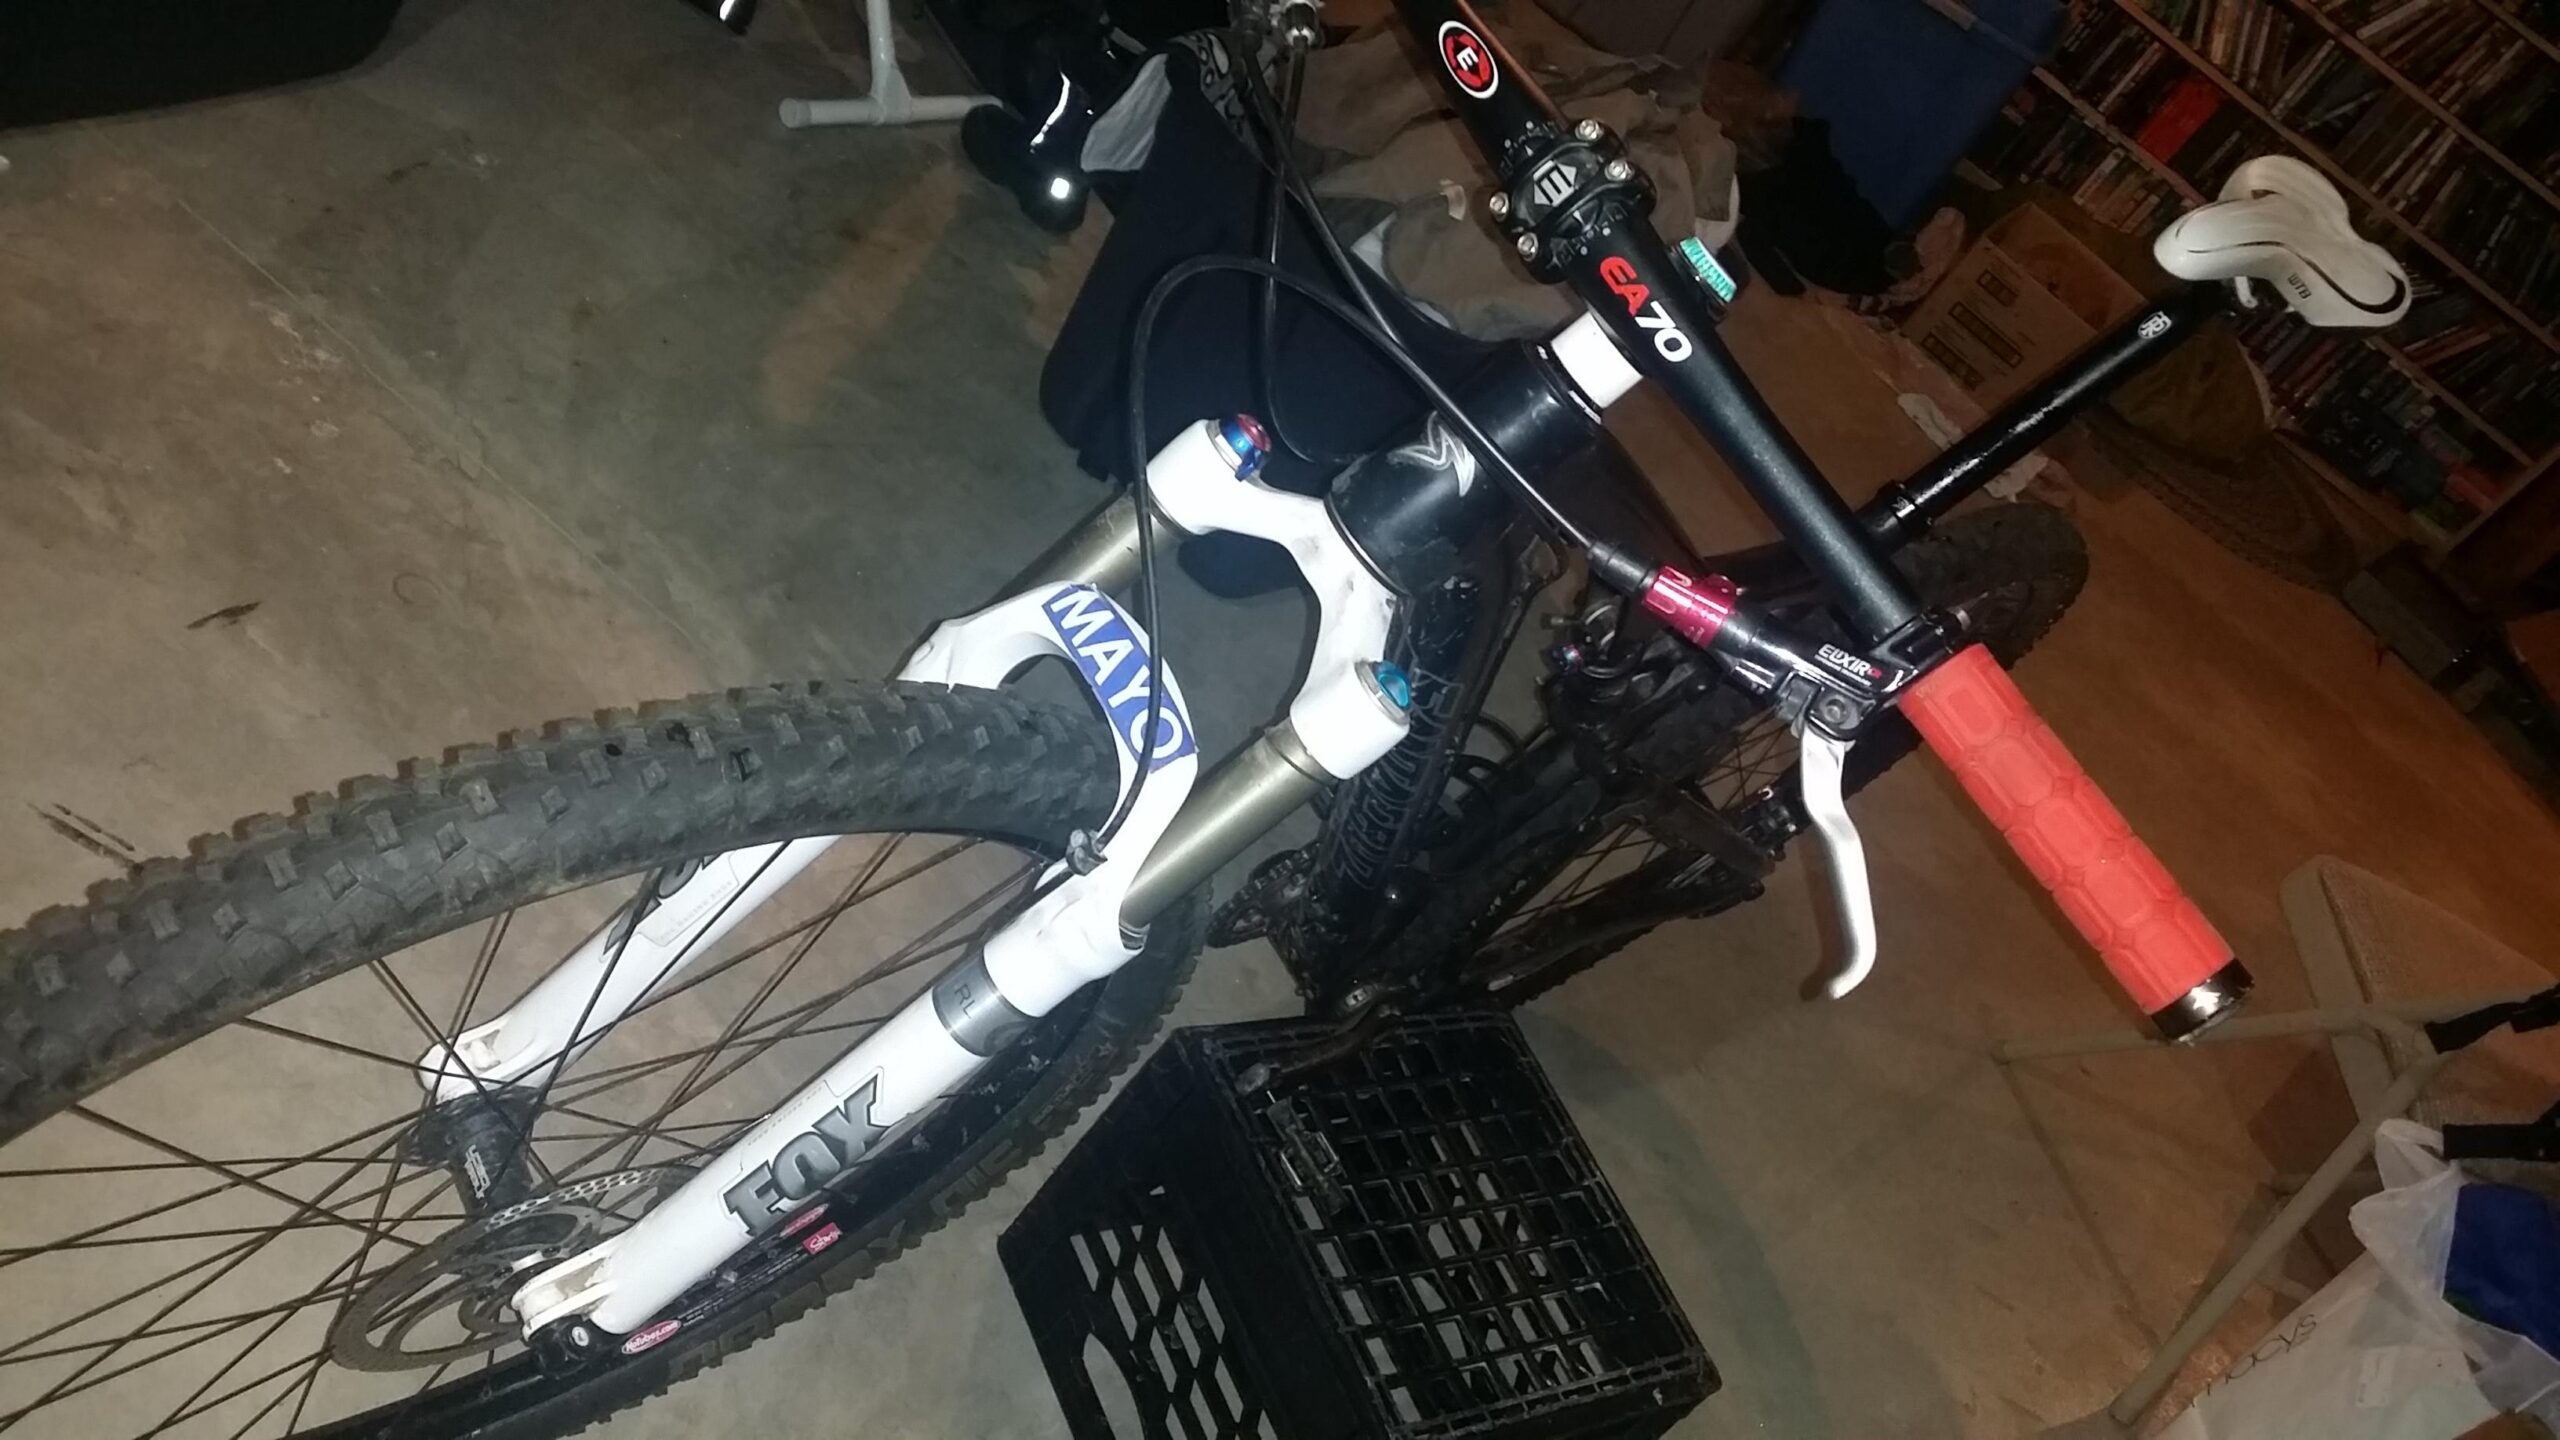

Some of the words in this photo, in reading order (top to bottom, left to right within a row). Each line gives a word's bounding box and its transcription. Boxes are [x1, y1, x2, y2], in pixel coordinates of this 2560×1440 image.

[1600, 256, 1693, 362] EA70
[1050, 590, 1183, 759] MAYO
[954, 983, 976, 1019] RL
[723, 1074, 889, 1238] FOX
